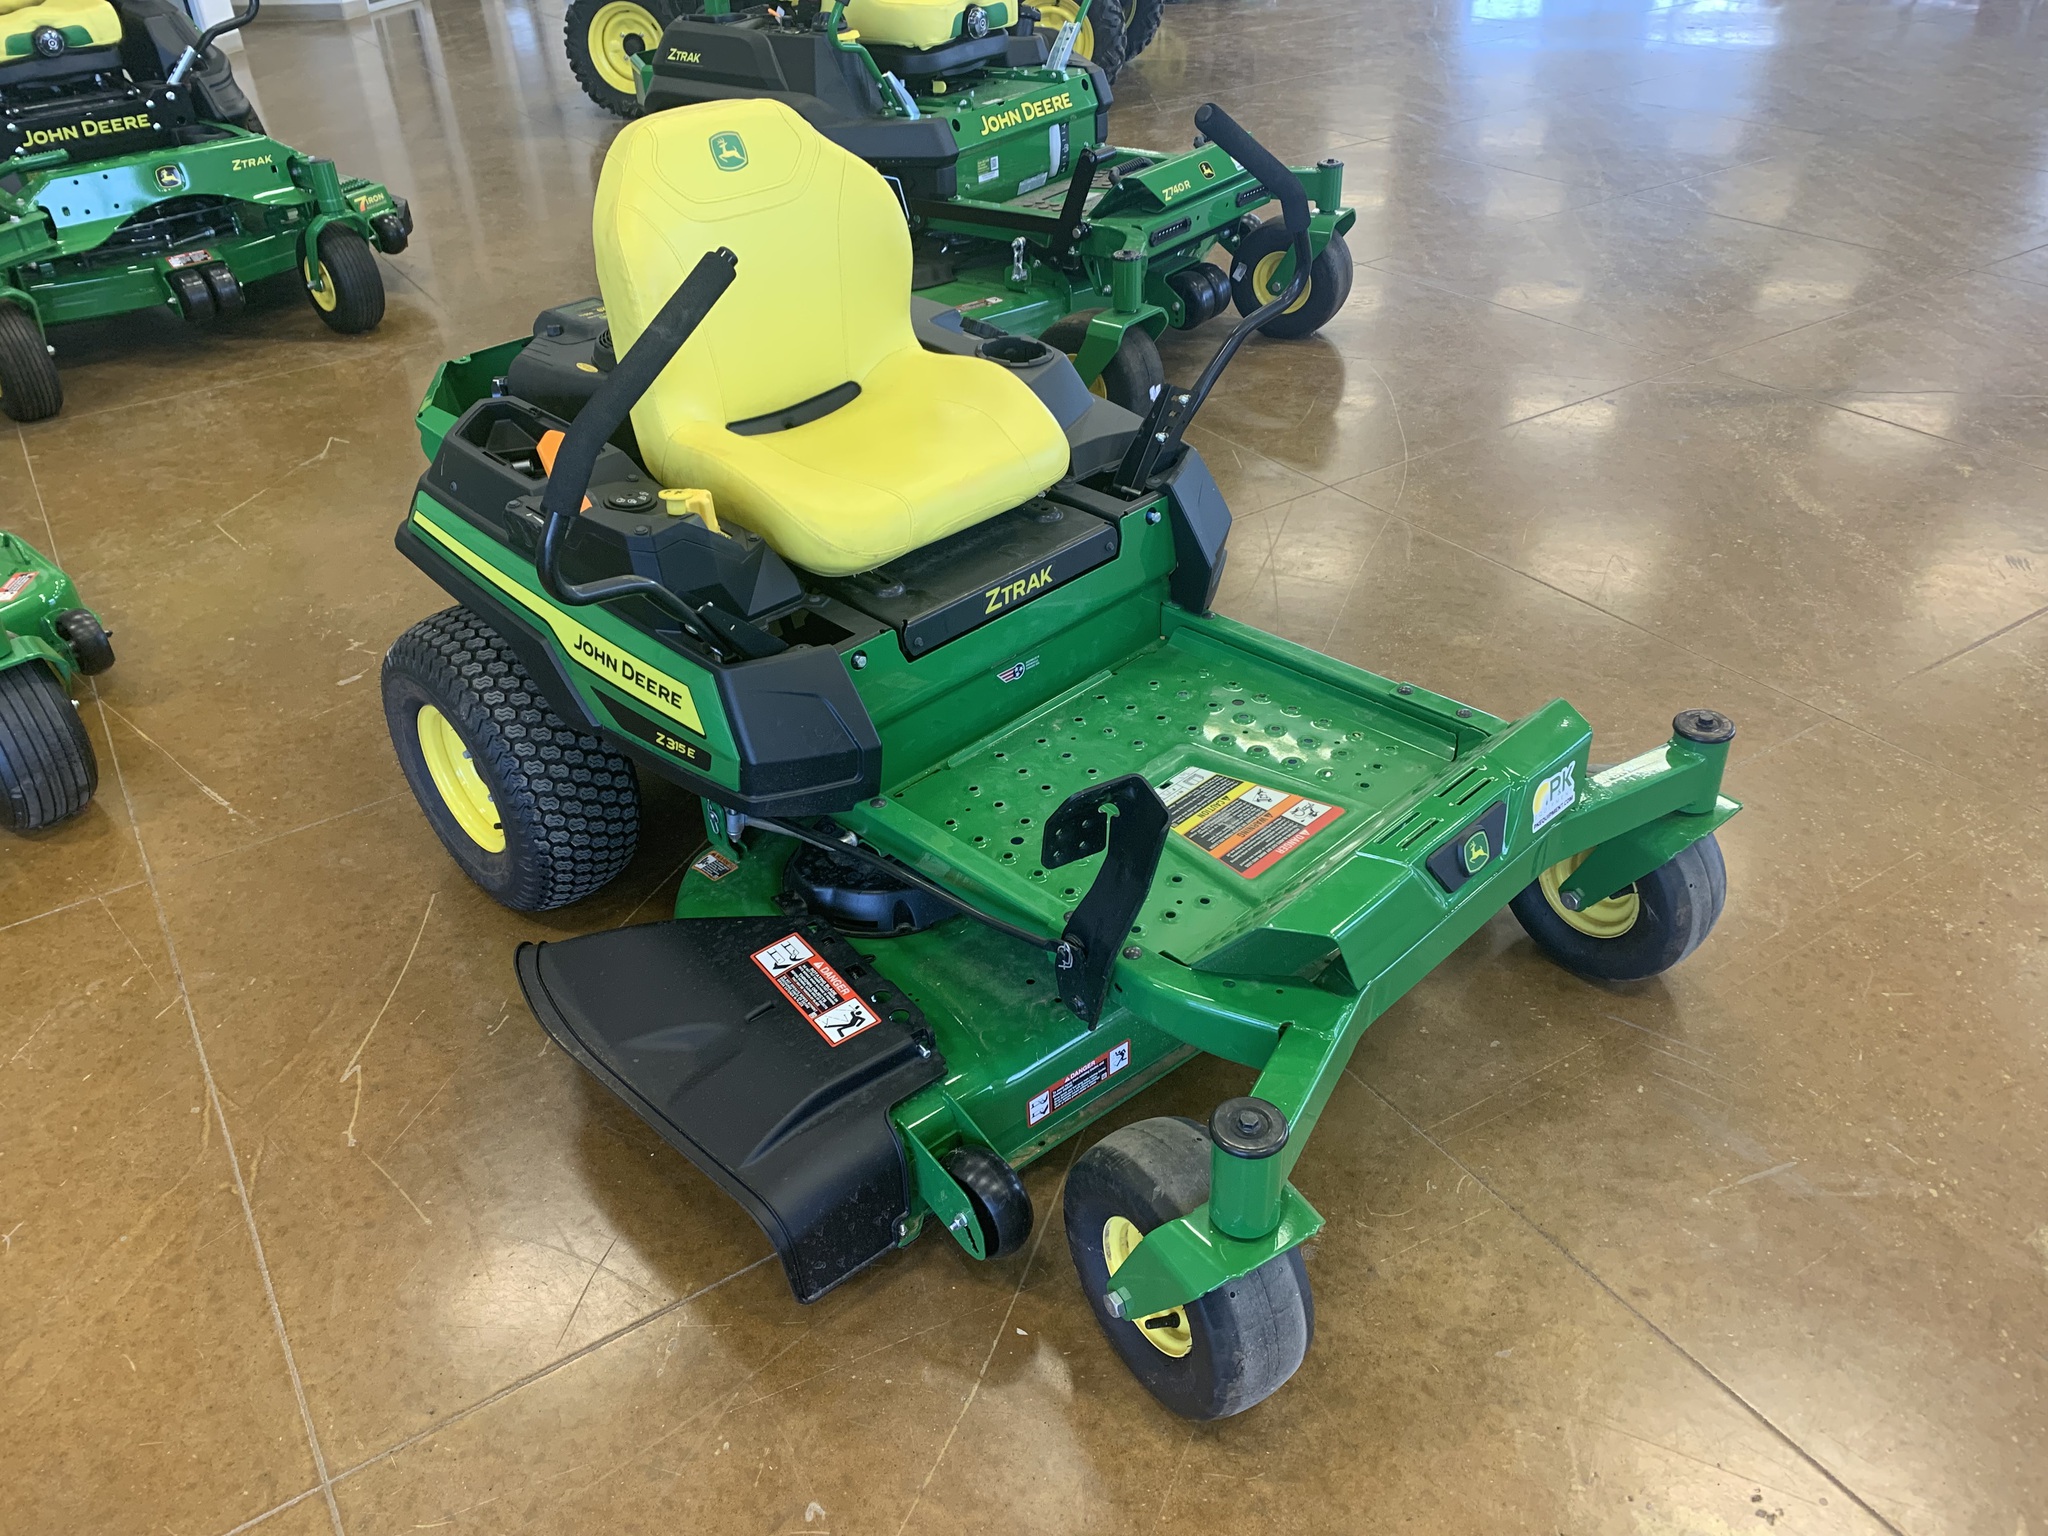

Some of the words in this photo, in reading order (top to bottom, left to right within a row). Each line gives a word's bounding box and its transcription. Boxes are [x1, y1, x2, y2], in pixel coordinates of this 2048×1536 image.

[667, 47, 701, 63] ZTRAK
[980, 108, 1022, 136] JOHN
[1021, 92, 1073, 122] DEERE
[22, 125, 79, 148] JOHN
[81, 113, 151, 137] DEERE
[231, 153, 273, 171] ZTRAK
[984, 564, 1053, 615] ZTRAK
[573, 633, 618, 673] JOHN
[621, 660, 683, 710] DEERE
[1275, 833, 1304, 856] DANGER
[819, 966, 851, 996] DANGER
[1070, 1060, 1096, 1079] DANGER
